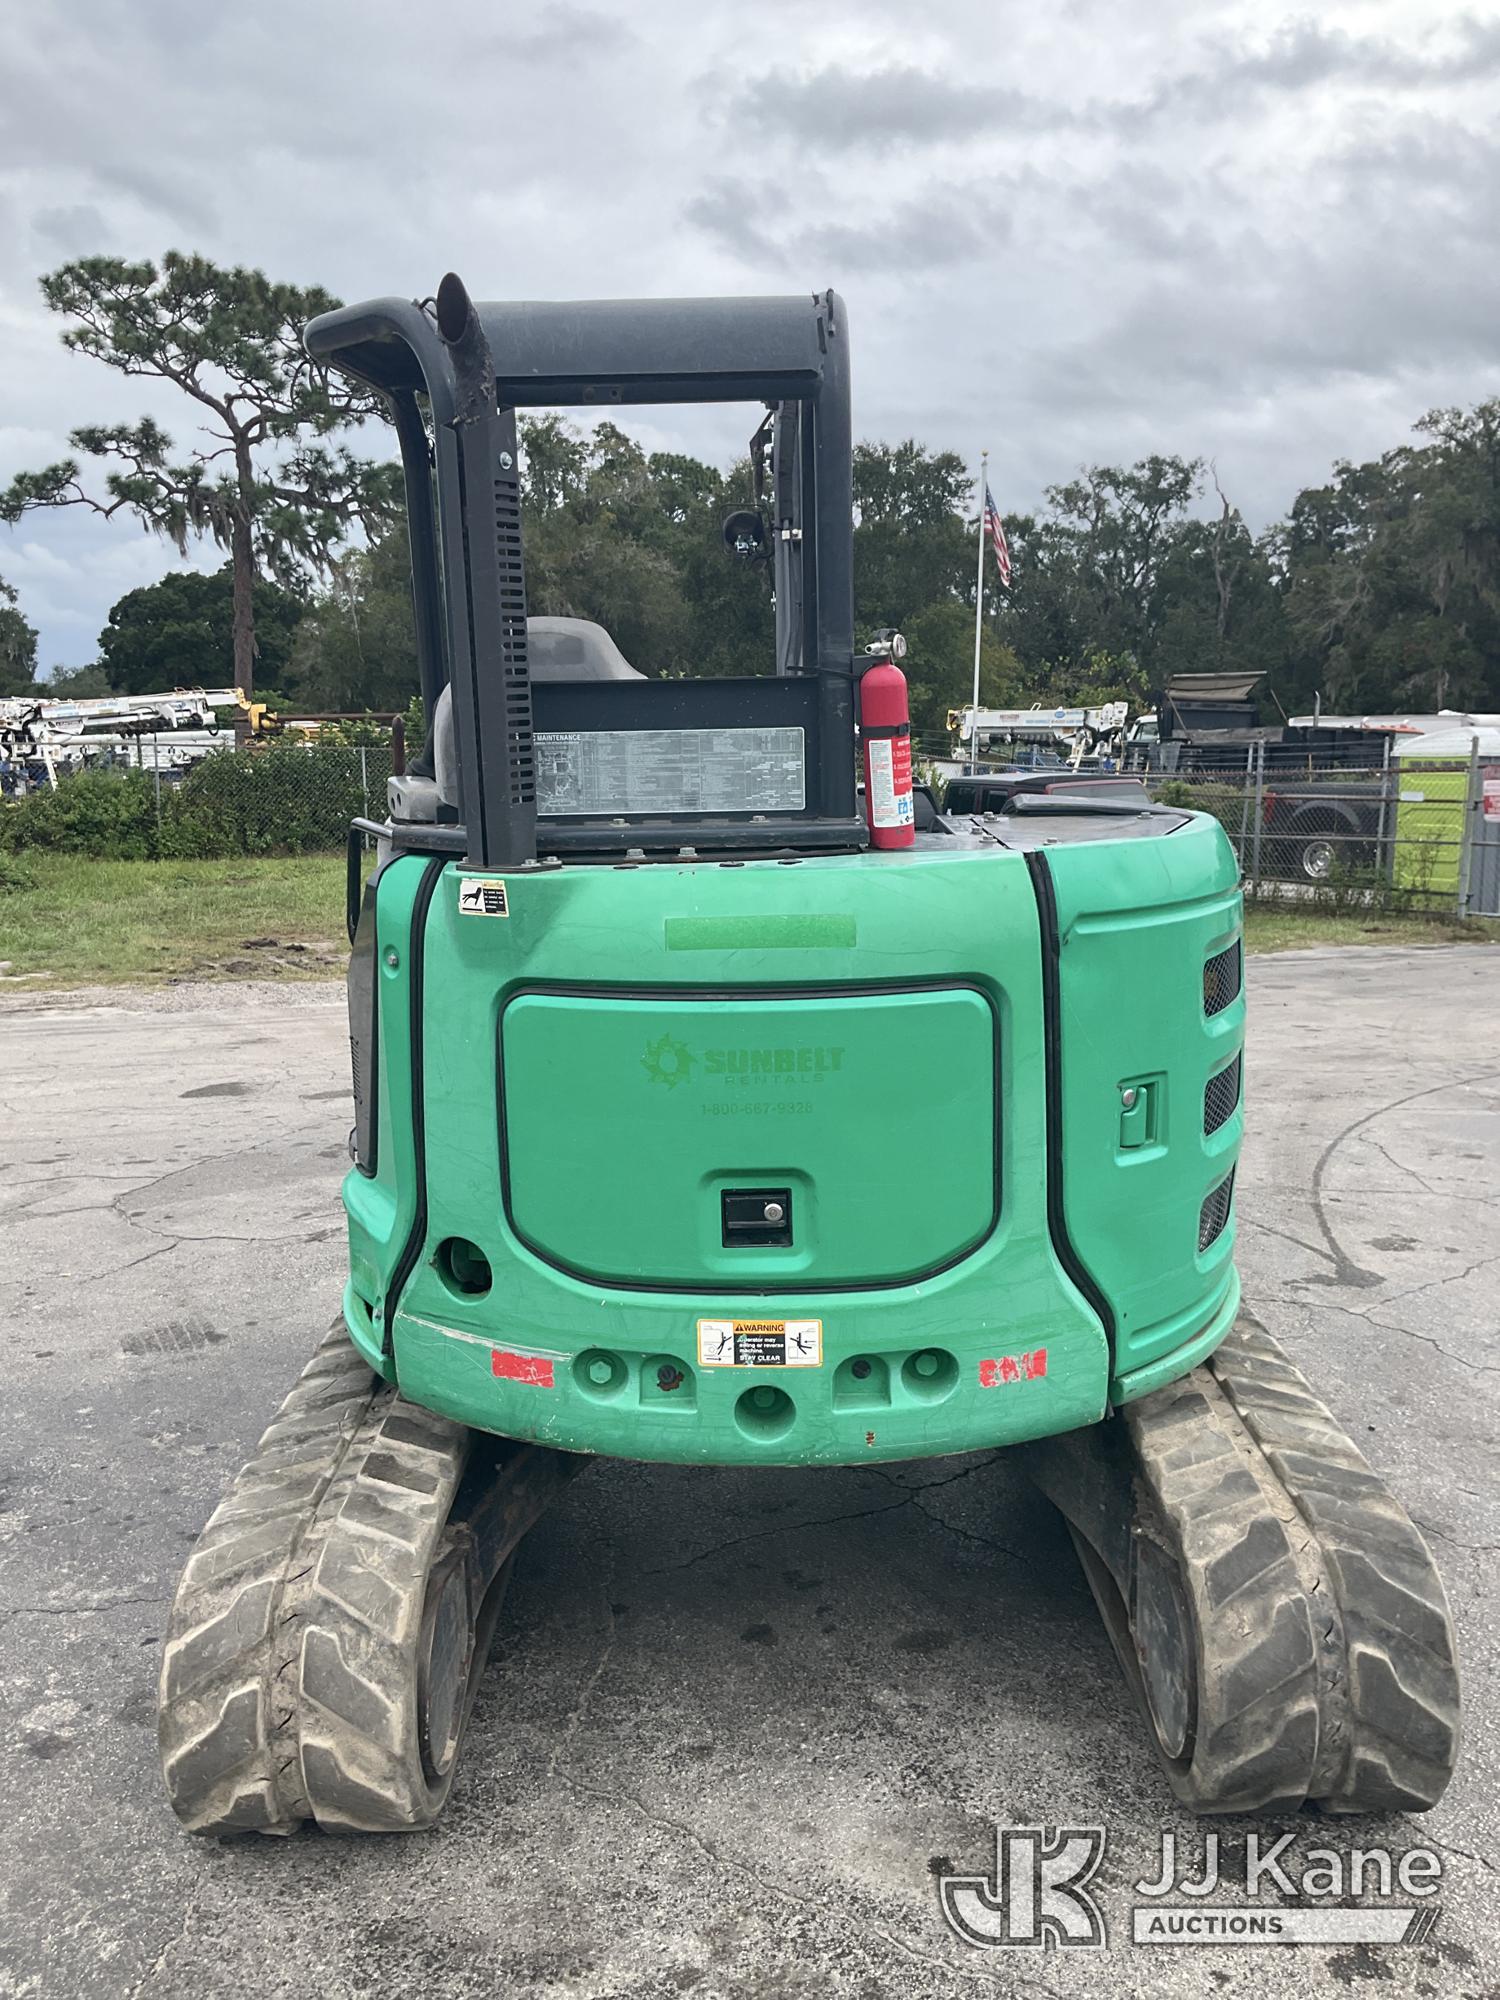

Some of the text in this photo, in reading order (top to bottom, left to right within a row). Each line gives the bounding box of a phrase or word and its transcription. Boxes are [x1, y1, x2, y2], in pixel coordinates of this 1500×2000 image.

[704, 1047, 845, 1074] SUNBELT
[724, 1073, 825, 1086] RENTALS
[743, 1324, 784, 1332] WARNING
